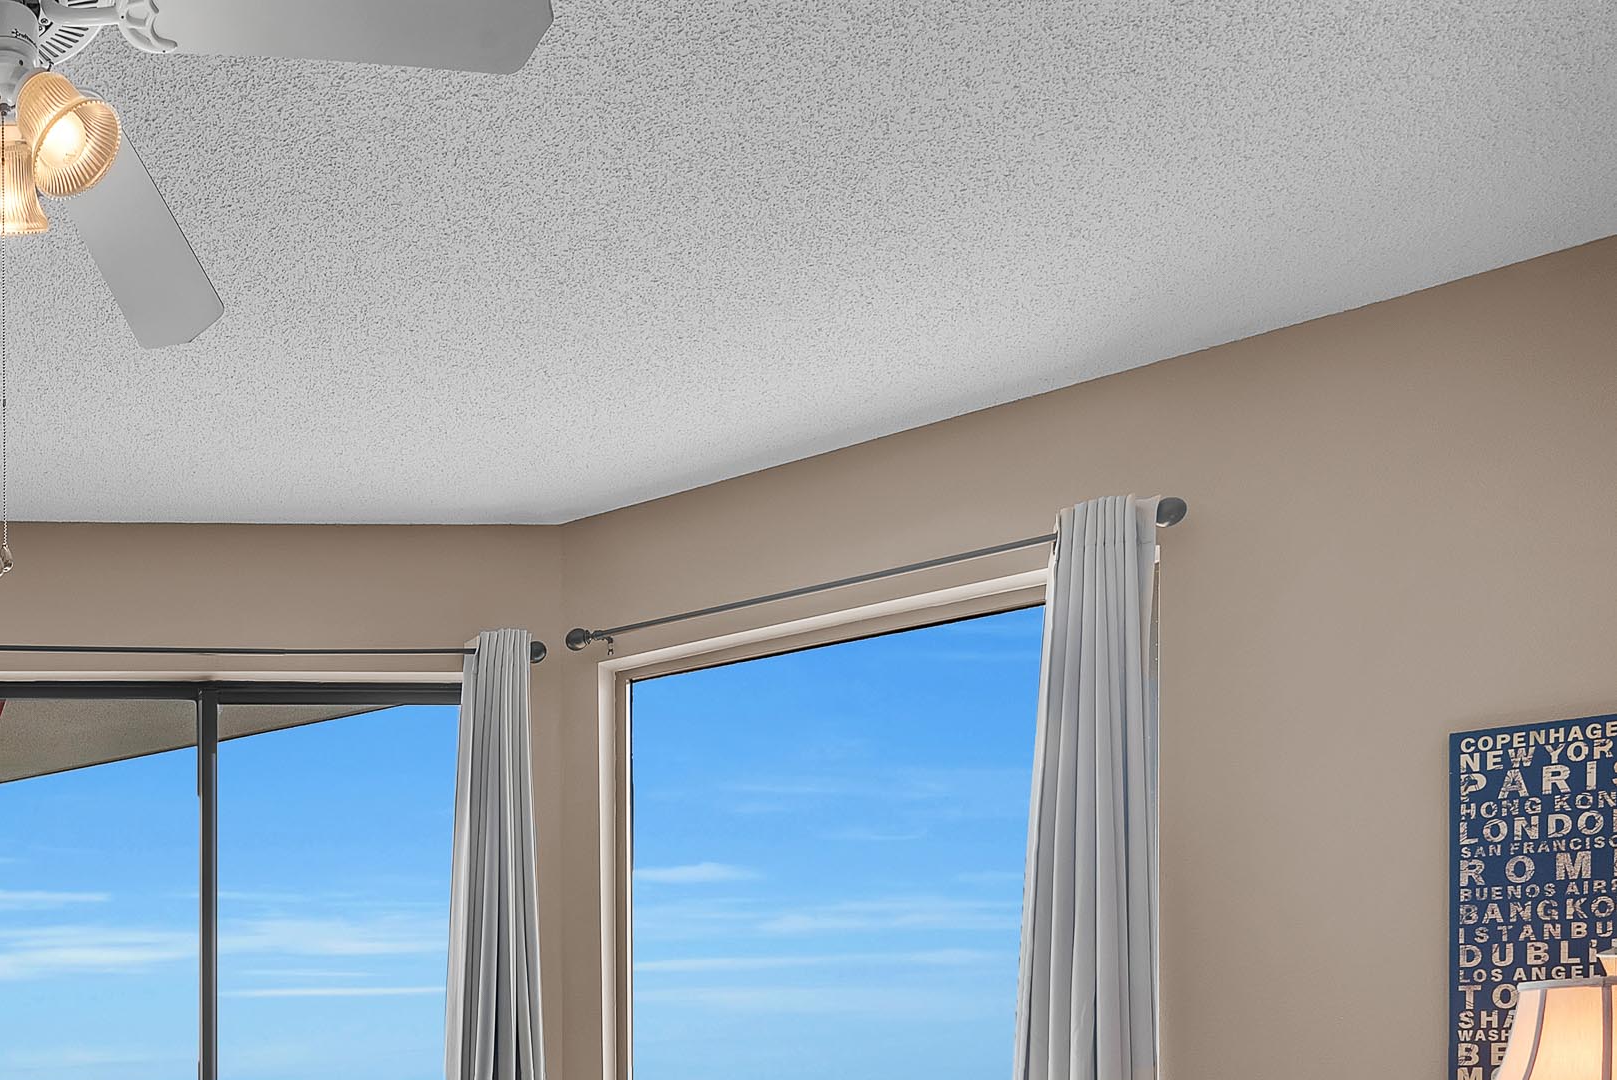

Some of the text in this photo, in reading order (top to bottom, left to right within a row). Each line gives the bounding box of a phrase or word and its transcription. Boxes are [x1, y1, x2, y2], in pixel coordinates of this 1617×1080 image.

[1460, 720, 1617, 753] COPENHAGE
[1460, 739, 1613, 773] NEW YOR
[1460, 761, 1617, 802] PARI
[1460, 791, 1617, 820] HONG KON
[1459, 808, 1617, 845] LONDO
[1461, 844, 1502, 858] SAN
[1459, 848, 1617, 887] ROM
[1459, 883, 1556, 902] BUENOS
[1459, 895, 1615, 925] BANGKO
[1458, 920, 1613, 944] ISTANBU
[1459, 938, 1617, 968] DUBLI
[1459, 968, 1503, 983] LOS
[1458, 983, 1518, 1010] TO
